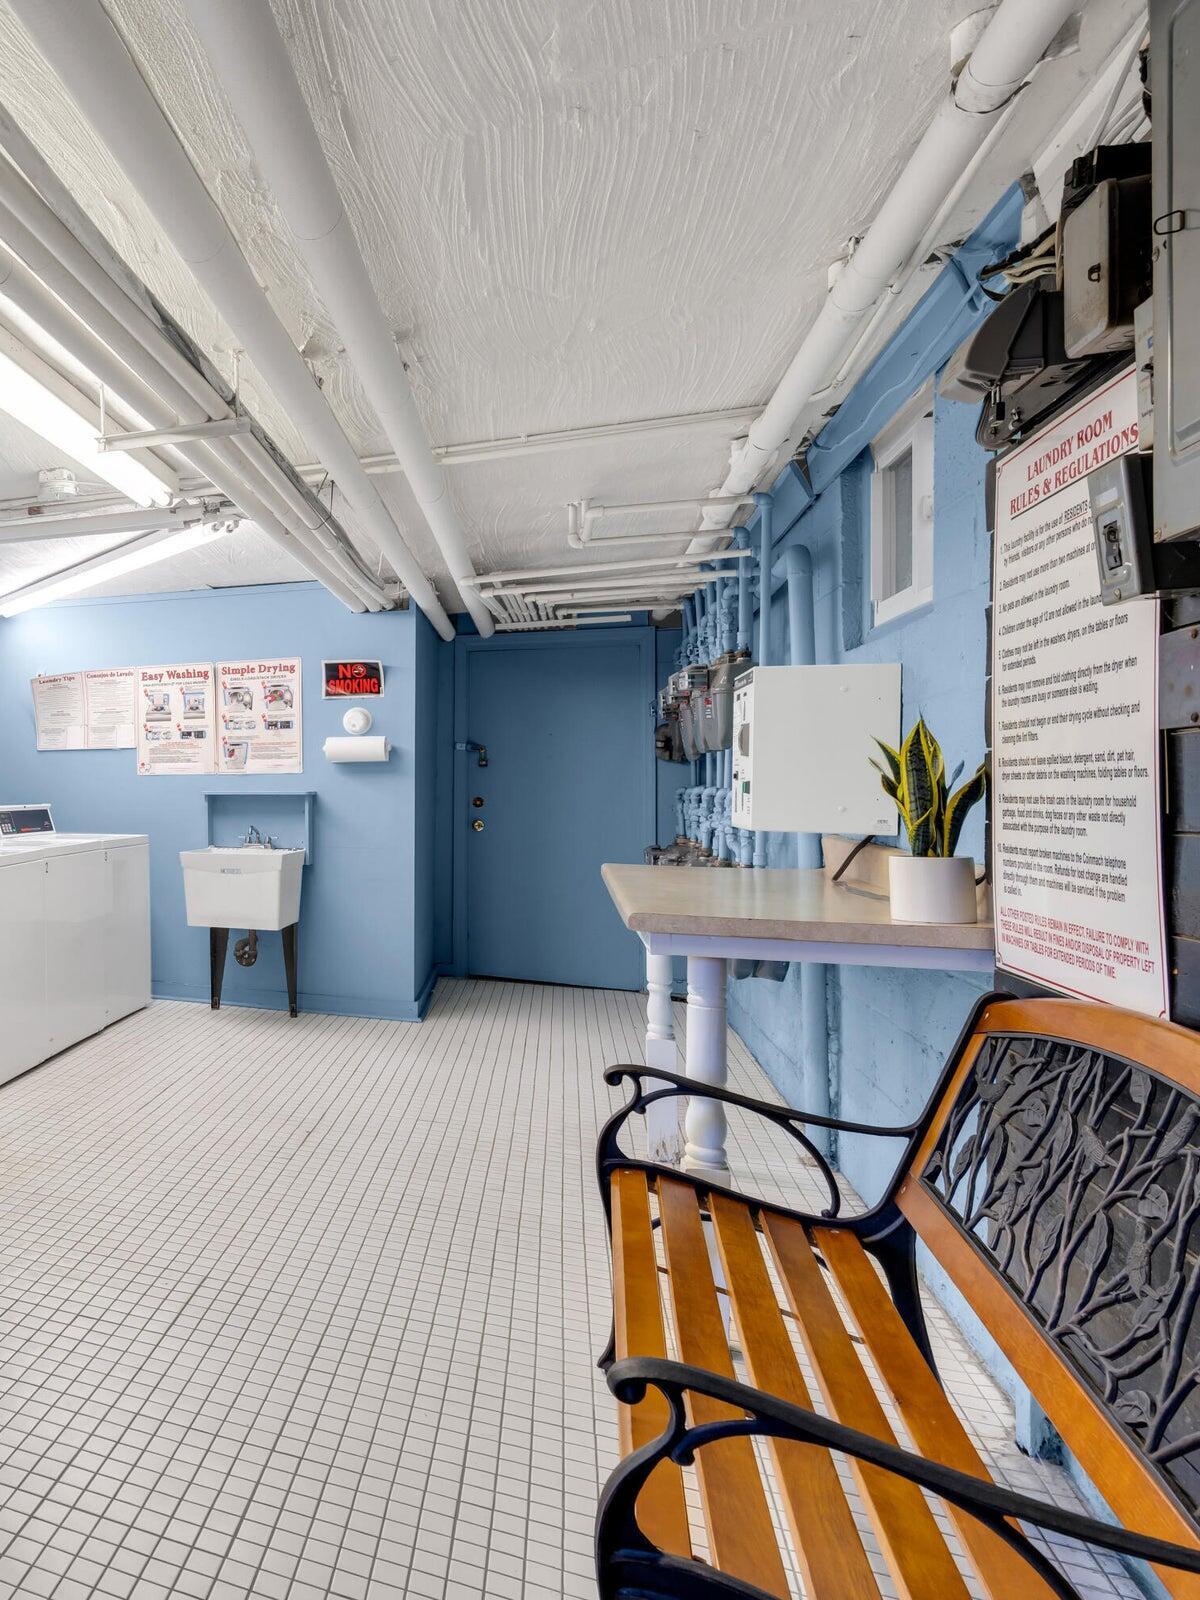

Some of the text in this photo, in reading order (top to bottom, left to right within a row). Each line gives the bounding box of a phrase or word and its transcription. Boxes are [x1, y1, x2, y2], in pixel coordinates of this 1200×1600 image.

[1027, 409, 1112, 482] LAUNDRY ROOM
[1010, 420, 1138, 515] RULES & REGULATIONS
[1064, 498, 1087, 521] RESIDENTS
[1082, 625, 1087, 635] on
[1095, 616, 1108, 631] tables
[1109, 617, 1113, 627] or
[1114, 610, 1128, 625] floors
[141, 669, 210, 682] Easy Washing
[222, 664, 296, 676] Simple Drying
[1060, 668, 1076, 685] clothing
[1077, 664, 1092, 681] directly
[1093, 662, 1102, 675] from
[1111, 657, 1123, 673] dryer
[1124, 654, 1136, 668] when
[328, 678, 379, 694] SMOKING
[1110, 701, 1130, 719] checking
[1131, 700, 1139, 713] and
[1098, 765, 1112, 781] folding
[1113, 765, 1126, 778] tables
[1128, 768, 1132, 778] or
[1093, 796, 1104, 806] room
[1112, 794, 1136, 807] household
[1076, 809, 1087, 821] other
[1088, 811, 1100, 822] waste
[1109, 810, 1125, 825] directly
[1052, 848, 1069, 862] machines
[1104, 854, 1126, 871] telephone
[1085, 868, 1100, 883] change
[1109, 872, 1127, 886] handled
[1106, 887, 1125, 904] problem
[1086, 926, 1148, 955] FAILURE TO COMPLY WITH
[1075, 954, 1094, 972] PERIODS
[1096, 961, 1102, 974] OF
[1082, 941, 1104, 959] DISPOSAL
[1105, 948, 1111, 962] OF
[1113, 950, 1139, 970] PROPERTY
[1141, 958, 1154, 974] LEFT
